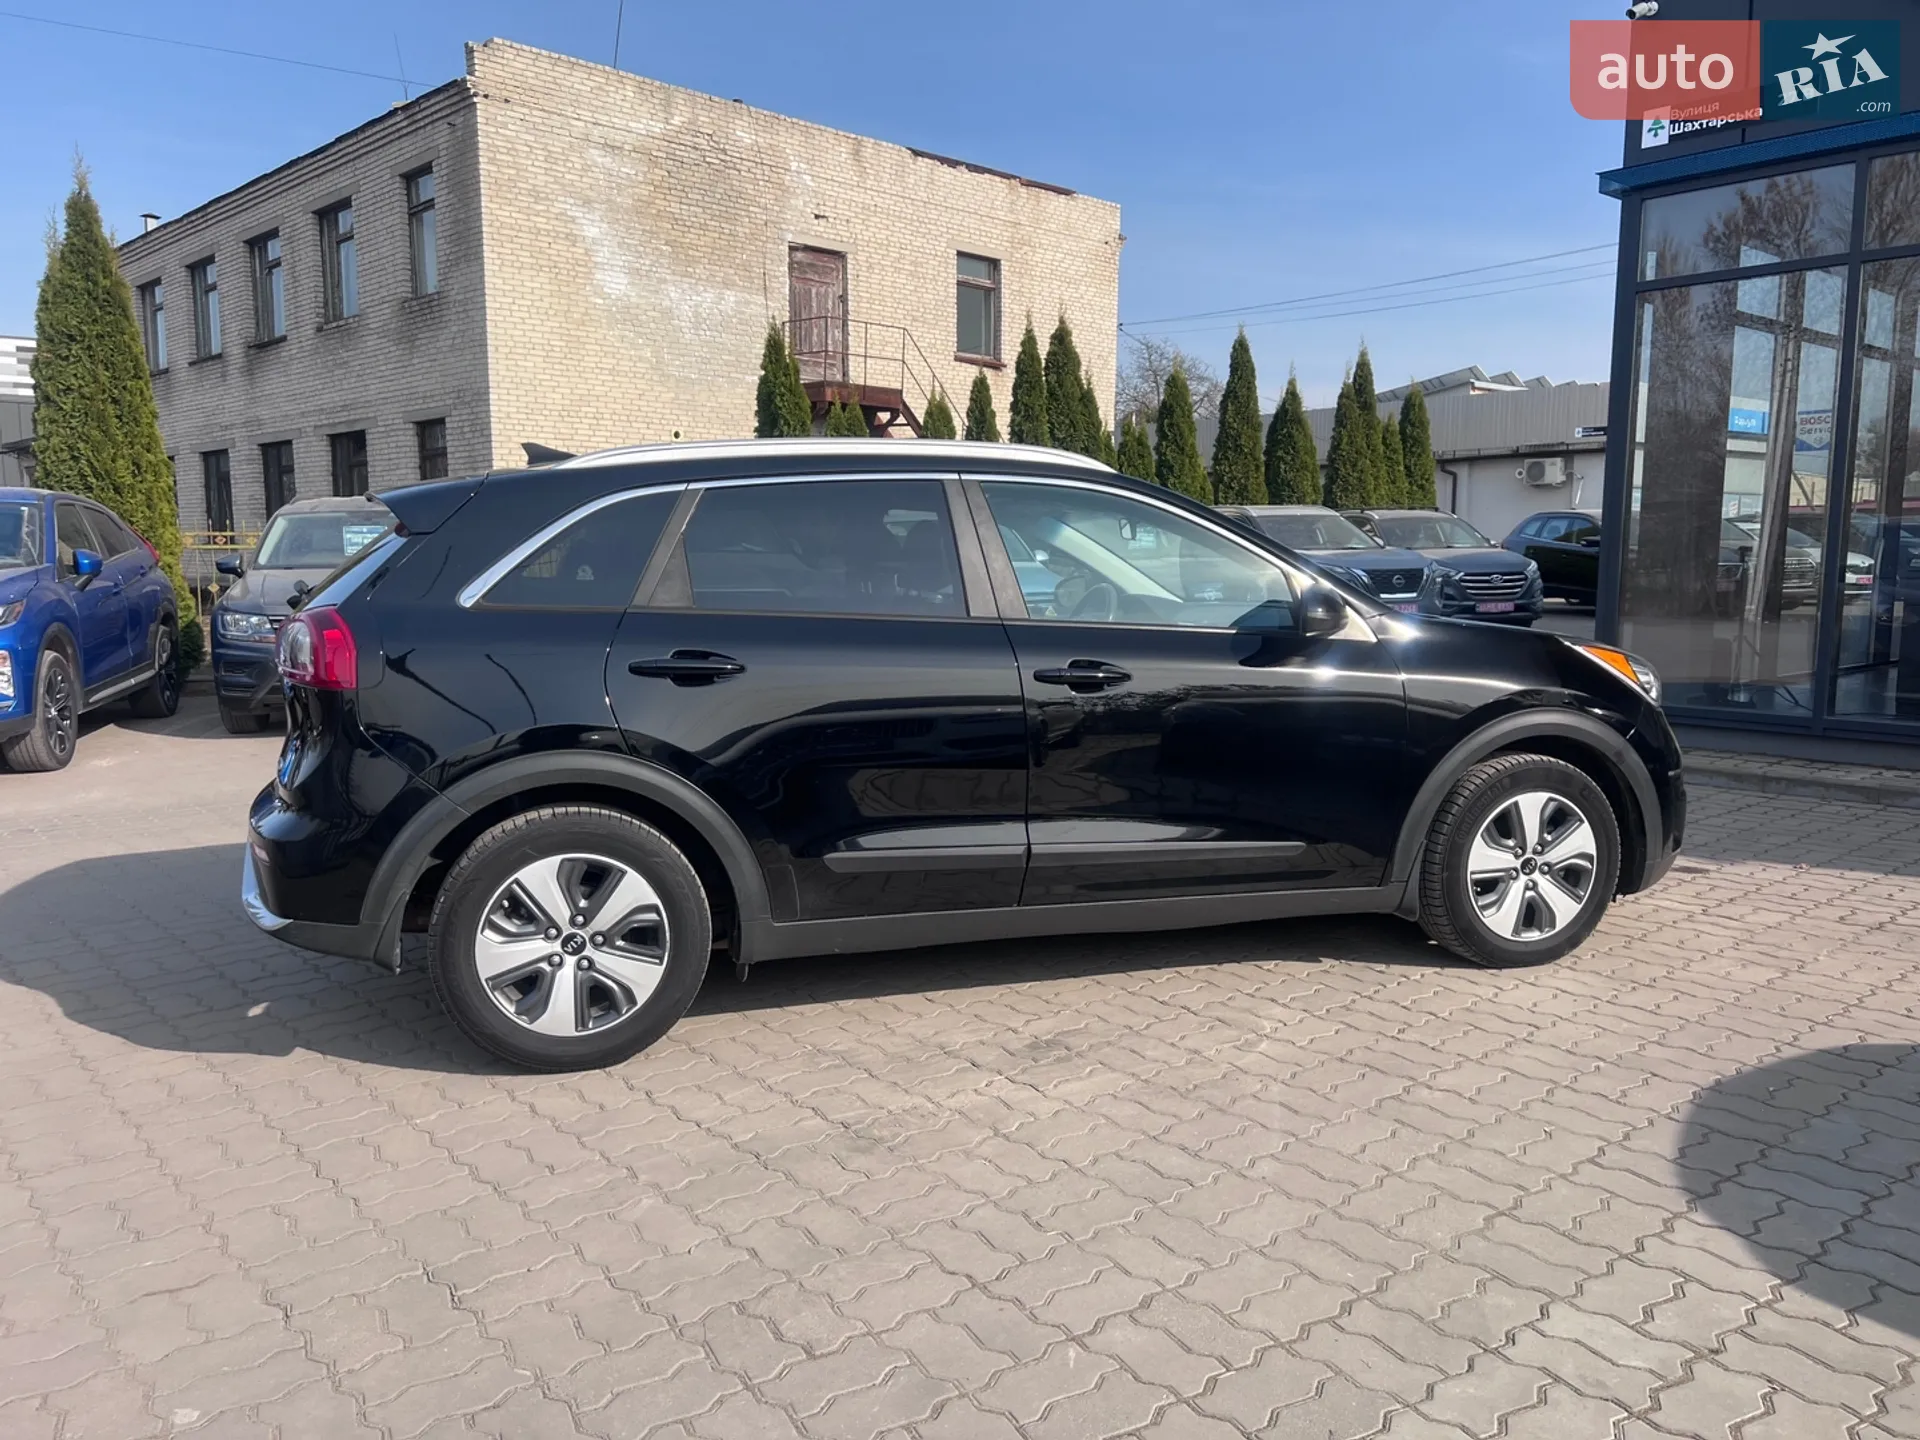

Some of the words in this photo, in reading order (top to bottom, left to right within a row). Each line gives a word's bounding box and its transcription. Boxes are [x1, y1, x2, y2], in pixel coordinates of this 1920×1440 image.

[1671, 102, 1720, 121] Вулиця
[1670, 107, 1763, 135] Шахтарська
[1800, 415, 1831, 426] BOSC
[1799, 426, 1832, 435] Servic
[1522, 858, 1536, 874] KIA
[563, 934, 584, 953] KIA
